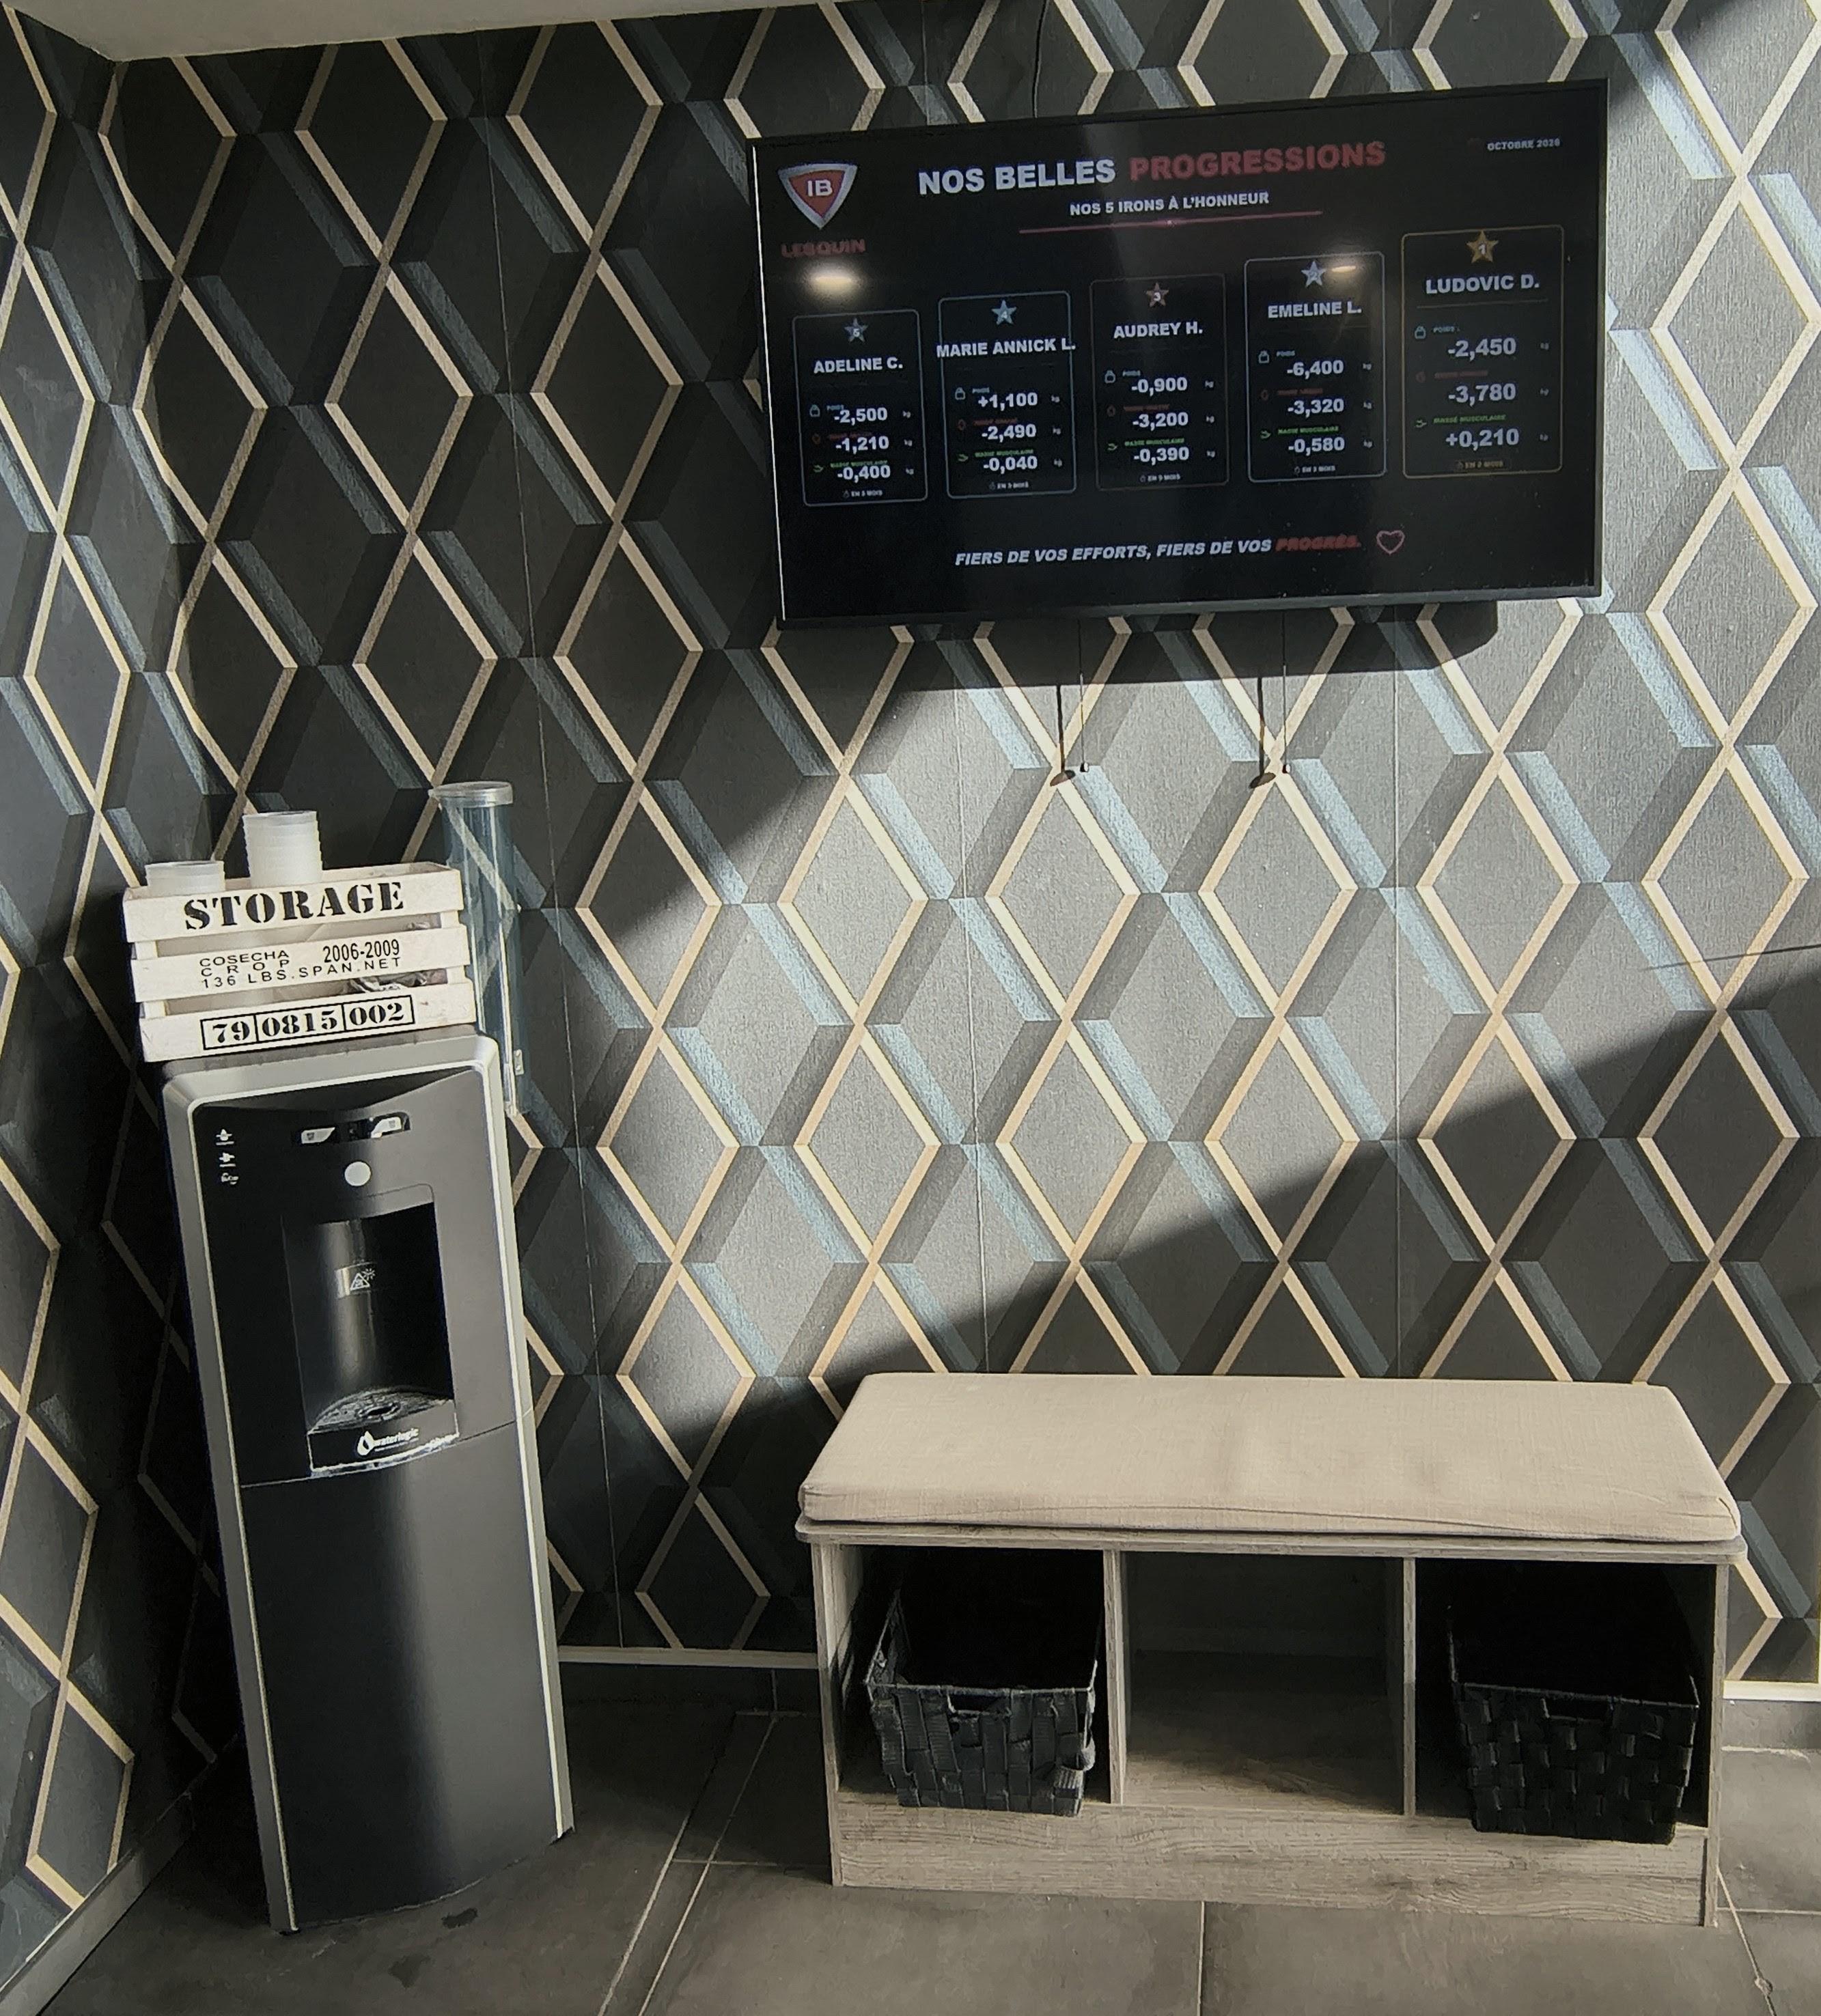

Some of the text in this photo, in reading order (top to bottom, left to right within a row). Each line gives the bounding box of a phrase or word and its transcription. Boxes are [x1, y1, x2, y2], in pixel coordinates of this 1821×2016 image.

[1487, 139, 1534, 151] OCTOBRE
[919, 140, 1387, 196] NOS BELLES PROGRESSIONS
[807, 179, 833, 197] IB
[1070, 191, 1269, 216] NOS 5 IRONS À L'HONNEUR
[1478, 243, 1486, 255] 1
[1426, 274, 1540, 295] LUDOVIC D.
[1154, 292, 1161, 302] 3
[1268, 300, 1363, 319] EMELINE L.
[1113, 321, 1204, 339] AUDREY H.
[936, 337, 1076, 358] MARIE ANNICK L.
[1447, 337, 1516, 362] -2,450
[814, 356, 904, 374] ADELINE C.
[1287, 359, 1344, 380] -6,400
[1131, 377, 1188, 397] -0,900
[1448, 382, 1517, 407] -3,780
[978, 392, 1038, 411] +1,100
[1288, 398, 1344, 418] -3,320
[834, 408, 888, 426] -2,500
[1132, 412, 1188, 432] -3,200
[982, 424, 1037, 443] -2,490
[1445, 428, 1520, 451] +0,210
[835, 436, 889, 455] -1,210
[1288, 436, 1345, 456] -0,580
[983, 456, 1038, 475] -0,040
[1133, 447, 1190, 466] -0,390
[837, 465, 891, 484] -0,400
[956, 549, 1003, 566] FIERS
[1007, 549, 1031, 563] DE
[1035, 547, 1068, 562] VOS
[1072, 544, 1152, 562] EFFORTS,
[1156, 542, 1206, 558] FIERS
[1210, 540, 1234, 555] DE
[1238, 538, 1273, 553] VOS
[184, 881, 404, 931] STORAGE
[199, 940, 400, 968] COSECHA 2006-2009
[203, 975, 237, 989] 136
[212, 1002, 405, 1044] 79 0815 002
